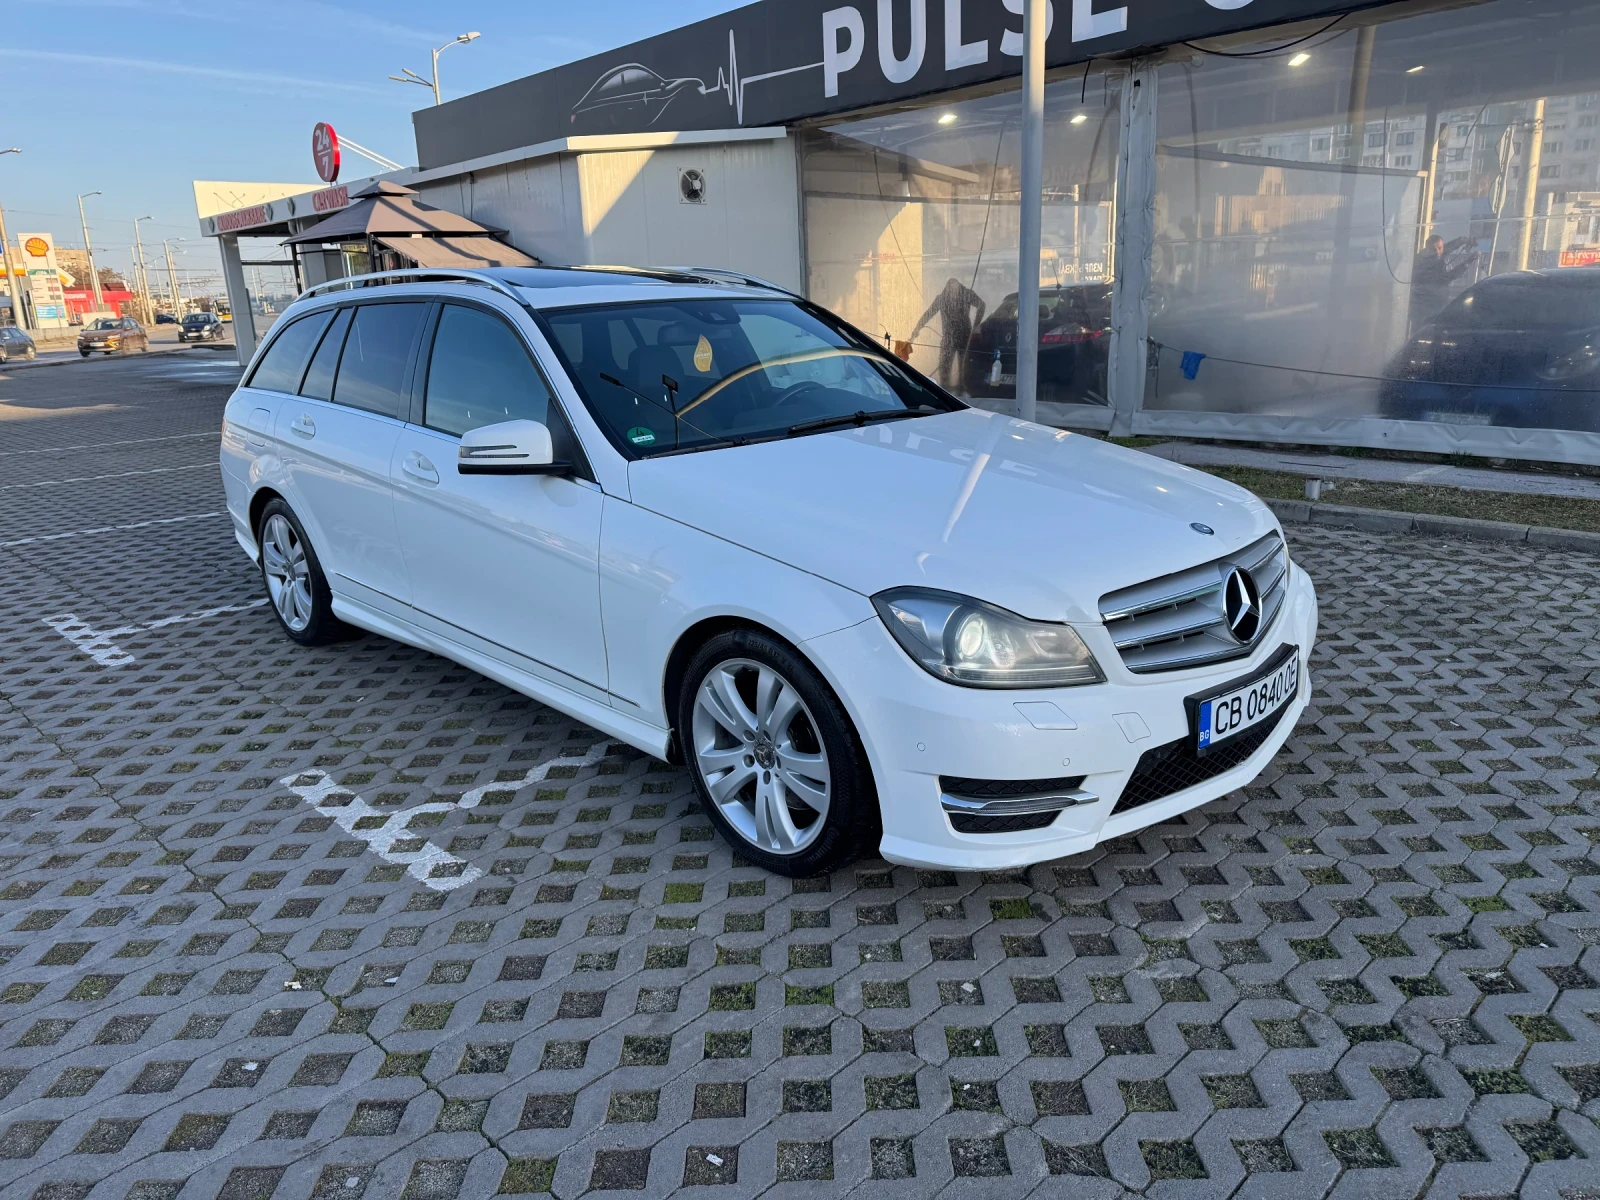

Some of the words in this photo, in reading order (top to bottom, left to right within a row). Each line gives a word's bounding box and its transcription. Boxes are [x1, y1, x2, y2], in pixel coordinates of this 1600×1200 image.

[822, 0, 1128, 98] PUL
[315, 127, 329, 150] 24
[322, 155, 329, 177] 7
[1216, 696, 1241, 734] CB
[1247, 671, 1283, 720] 0840
[1284, 656, 1297, 694] OE
[1200, 730, 1209, 741] BG
